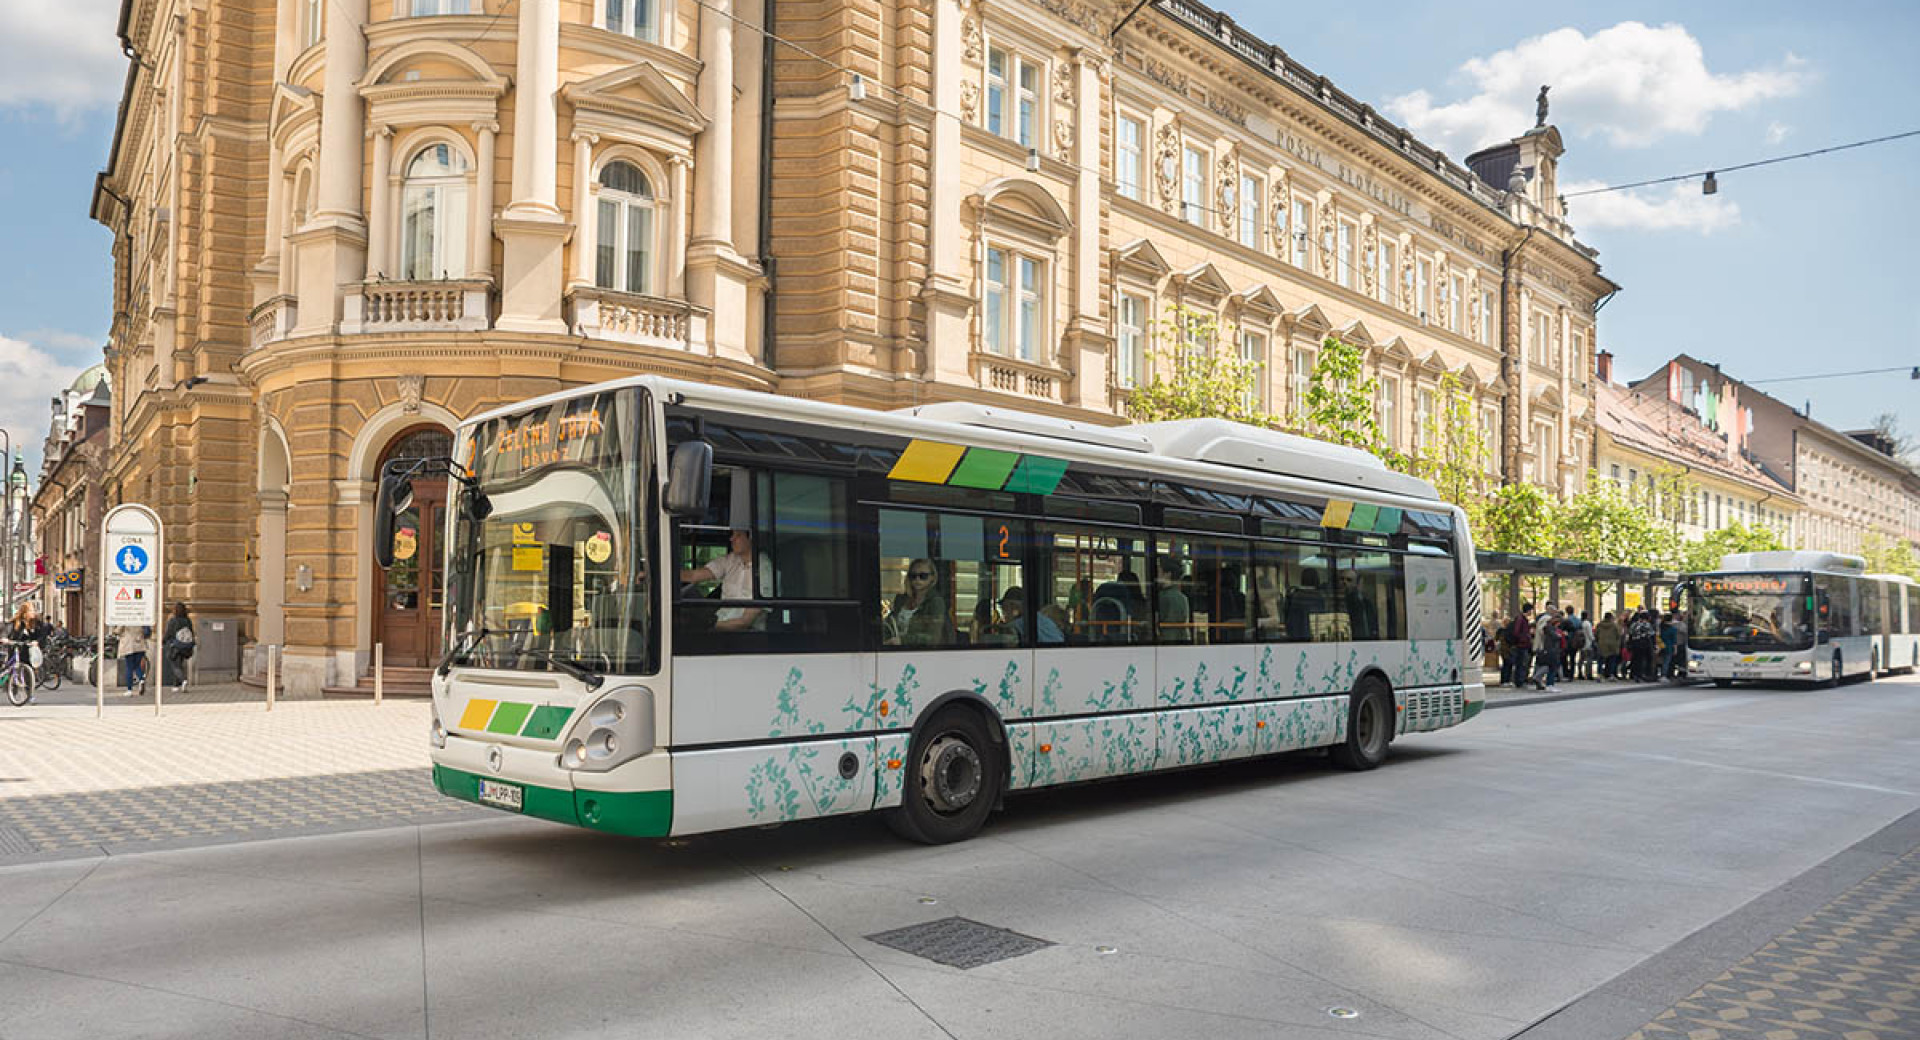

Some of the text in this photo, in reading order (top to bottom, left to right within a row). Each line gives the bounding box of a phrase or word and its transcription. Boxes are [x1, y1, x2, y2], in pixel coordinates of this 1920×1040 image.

[1276, 127, 1409, 216] POŠTA SLOVENIJE
[999, 524, 1009, 558] 2
